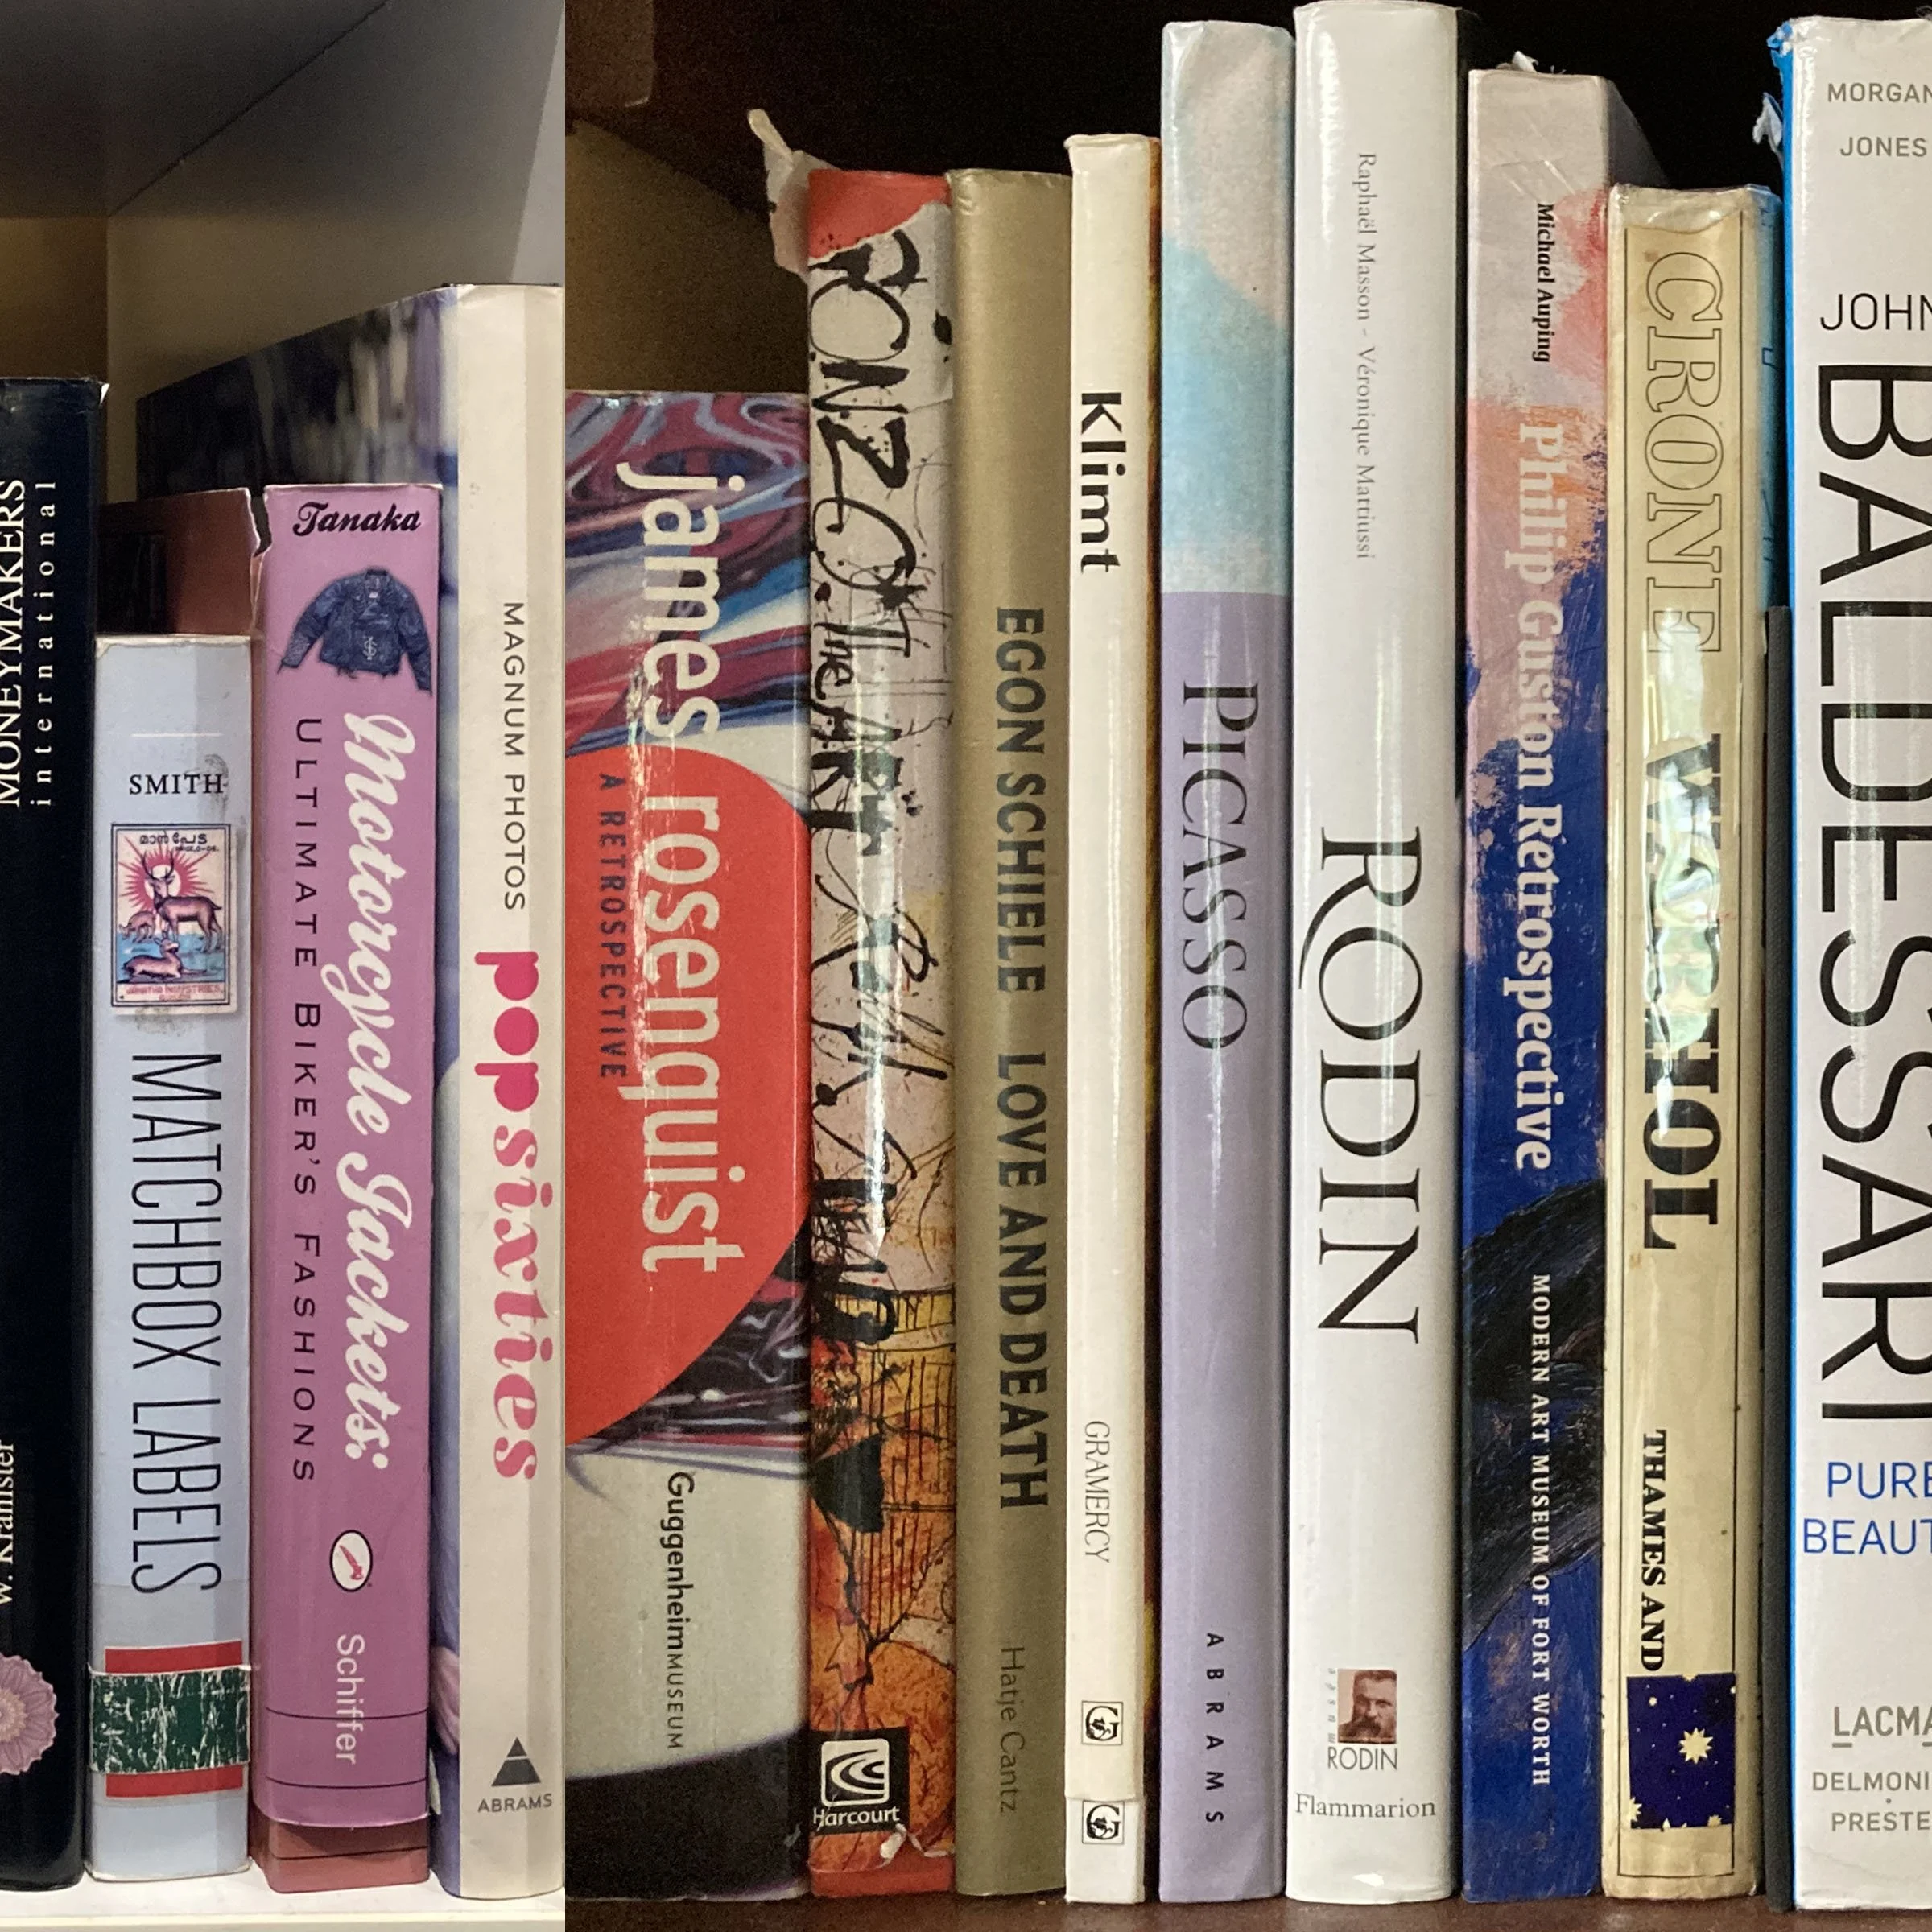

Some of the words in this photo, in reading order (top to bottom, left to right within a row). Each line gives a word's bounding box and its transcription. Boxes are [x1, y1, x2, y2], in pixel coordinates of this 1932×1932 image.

[1352, 153, 1377, 234] Raphaël
[1839, 136, 1928, 158] JONES
[1356, 244, 1376, 320] Masson
[1536, 203, 1555, 283] Michael
[1532, 288, 1555, 363] Auping
[1352, 346, 1376, 456] Véronique
[1644, 251, 1724, 653] CRONE
[291, 501, 422, 537] Tanaka
[1080, 391, 1127, 574] Klimt
[1356, 464, 1376, 559] Mattiussi
[1505, 423, 1569, 585] Philip
[0, 479, 26, 808] MONEYMAKERS
[30, 481, 57, 807] international
[616, 461, 745, 740] james
[503, 602, 526, 756] MAGNUM
[995, 607, 1047, 754] EGON
[1516, 600, 1564, 792] Guston
[129, 773, 225, 795] SMITH
[294, 718, 323, 968] ULTIMATE
[503, 774, 526, 911] PHOTOS
[600, 772, 627, 790] A
[320, 712, 416, 1136] Motorcycle
[996, 772, 1046, 993] SCHIELE
[1180, 681, 1259, 1051] PICASSO
[1818, 365, 1932, 1419] BALDESSARI
[597, 810, 628, 1079] RETROSPECTIVE
[1502, 803, 1564, 1170] Retrospective
[1642, 733, 1722, 1249] WRHOL
[294, 1003, 322, 1195] BIKER'S
[618, 794, 745, 1274] rosenquist
[1298, 826, 1424, 1344] RODIN
[996, 1054, 1047, 1187] LOVE
[130, 1053, 224, 1370] MATCHBOX
[998, 1206, 1047, 1317] AND
[292, 1233, 321, 1481] FASHIONS
[336, 1151, 414, 1470] Jackets:
[1532, 1274, 1551, 1381] MODERN
[998, 1333, 1049, 1510] DEATH
[1532, 1394, 1551, 1443] ART
[130, 1398, 222, 1593] LABELS
[1084, 1419, 1111, 1564] GRAMERCY
[1531, 1455, 1551, 1571] MUSEUM
[1641, 1430, 1667, 1587] THAMES
[1531, 1575, 1550, 1607] OF
[1531, 1611, 1550, 1685] FORT
[1641, 1593, 1666, 1672] AND
[335, 1633, 365, 1766] Schiffer
[998, 1646, 1026, 1722] Hatje
[1531, 1691, 1551, 1786] WORTH
[477, 1793, 553, 1813] ABRAMS
[813, 1804, 900, 1829] Harcourt
[998, 1730, 1026, 1813] Cantz
[1294, 1792, 1436, 1818] Flammarion
[1327, 1747, 1398, 1770] RODIN
[1812, 1770, 1930, 1793] DELMONI
[1831, 1811, 1931, 1832] PRESTE
